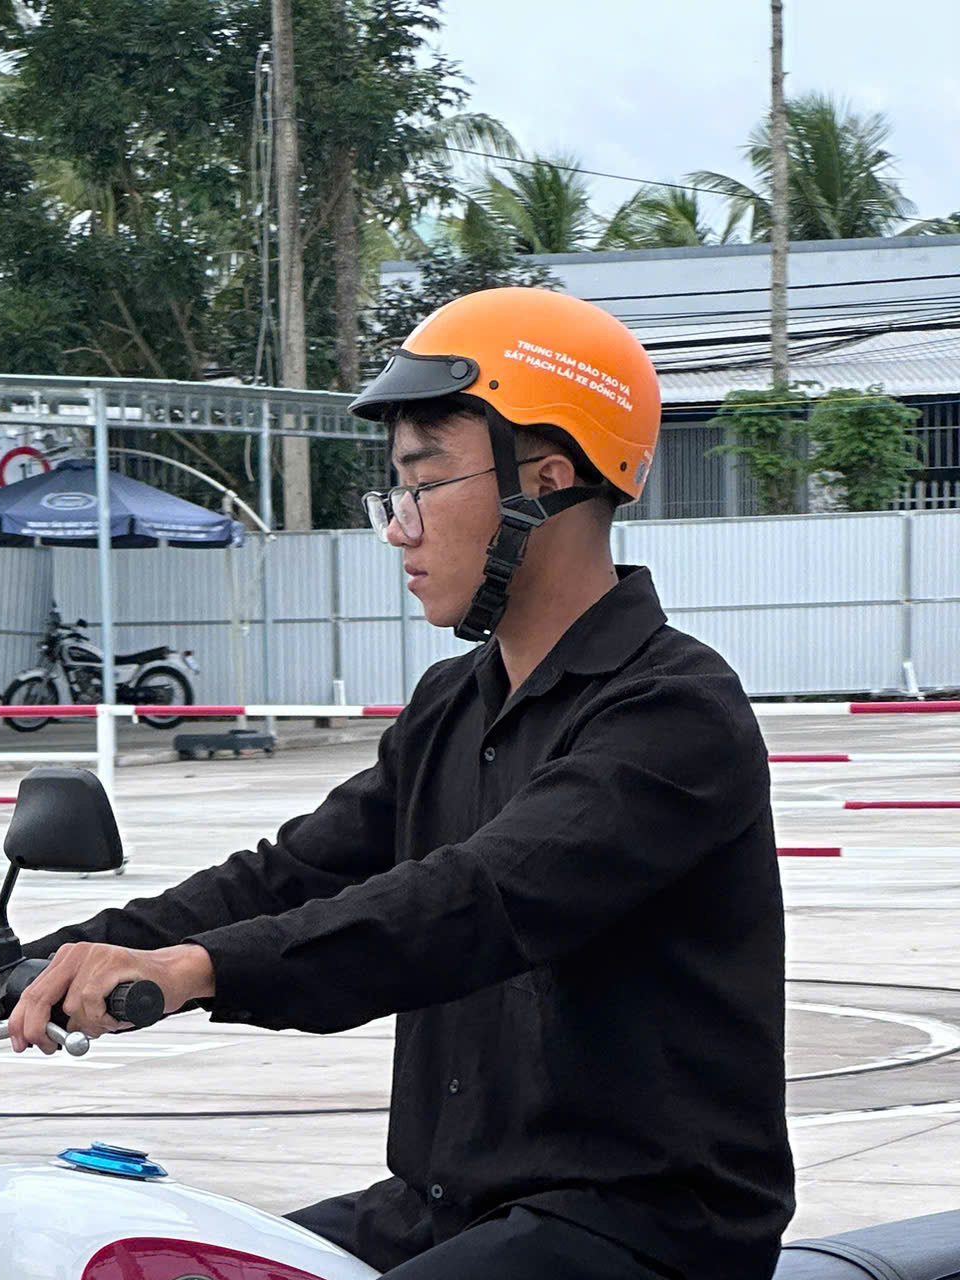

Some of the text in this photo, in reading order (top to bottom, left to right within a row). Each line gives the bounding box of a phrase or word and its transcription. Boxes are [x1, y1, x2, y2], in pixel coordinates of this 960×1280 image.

[503, 349, 526, 362] SÁT
[525, 355, 556, 374] HẠCH
[575, 374, 589, 386] XE
[517, 340, 553, 358] TRUNG
[600, 372, 619, 388] TẠO
